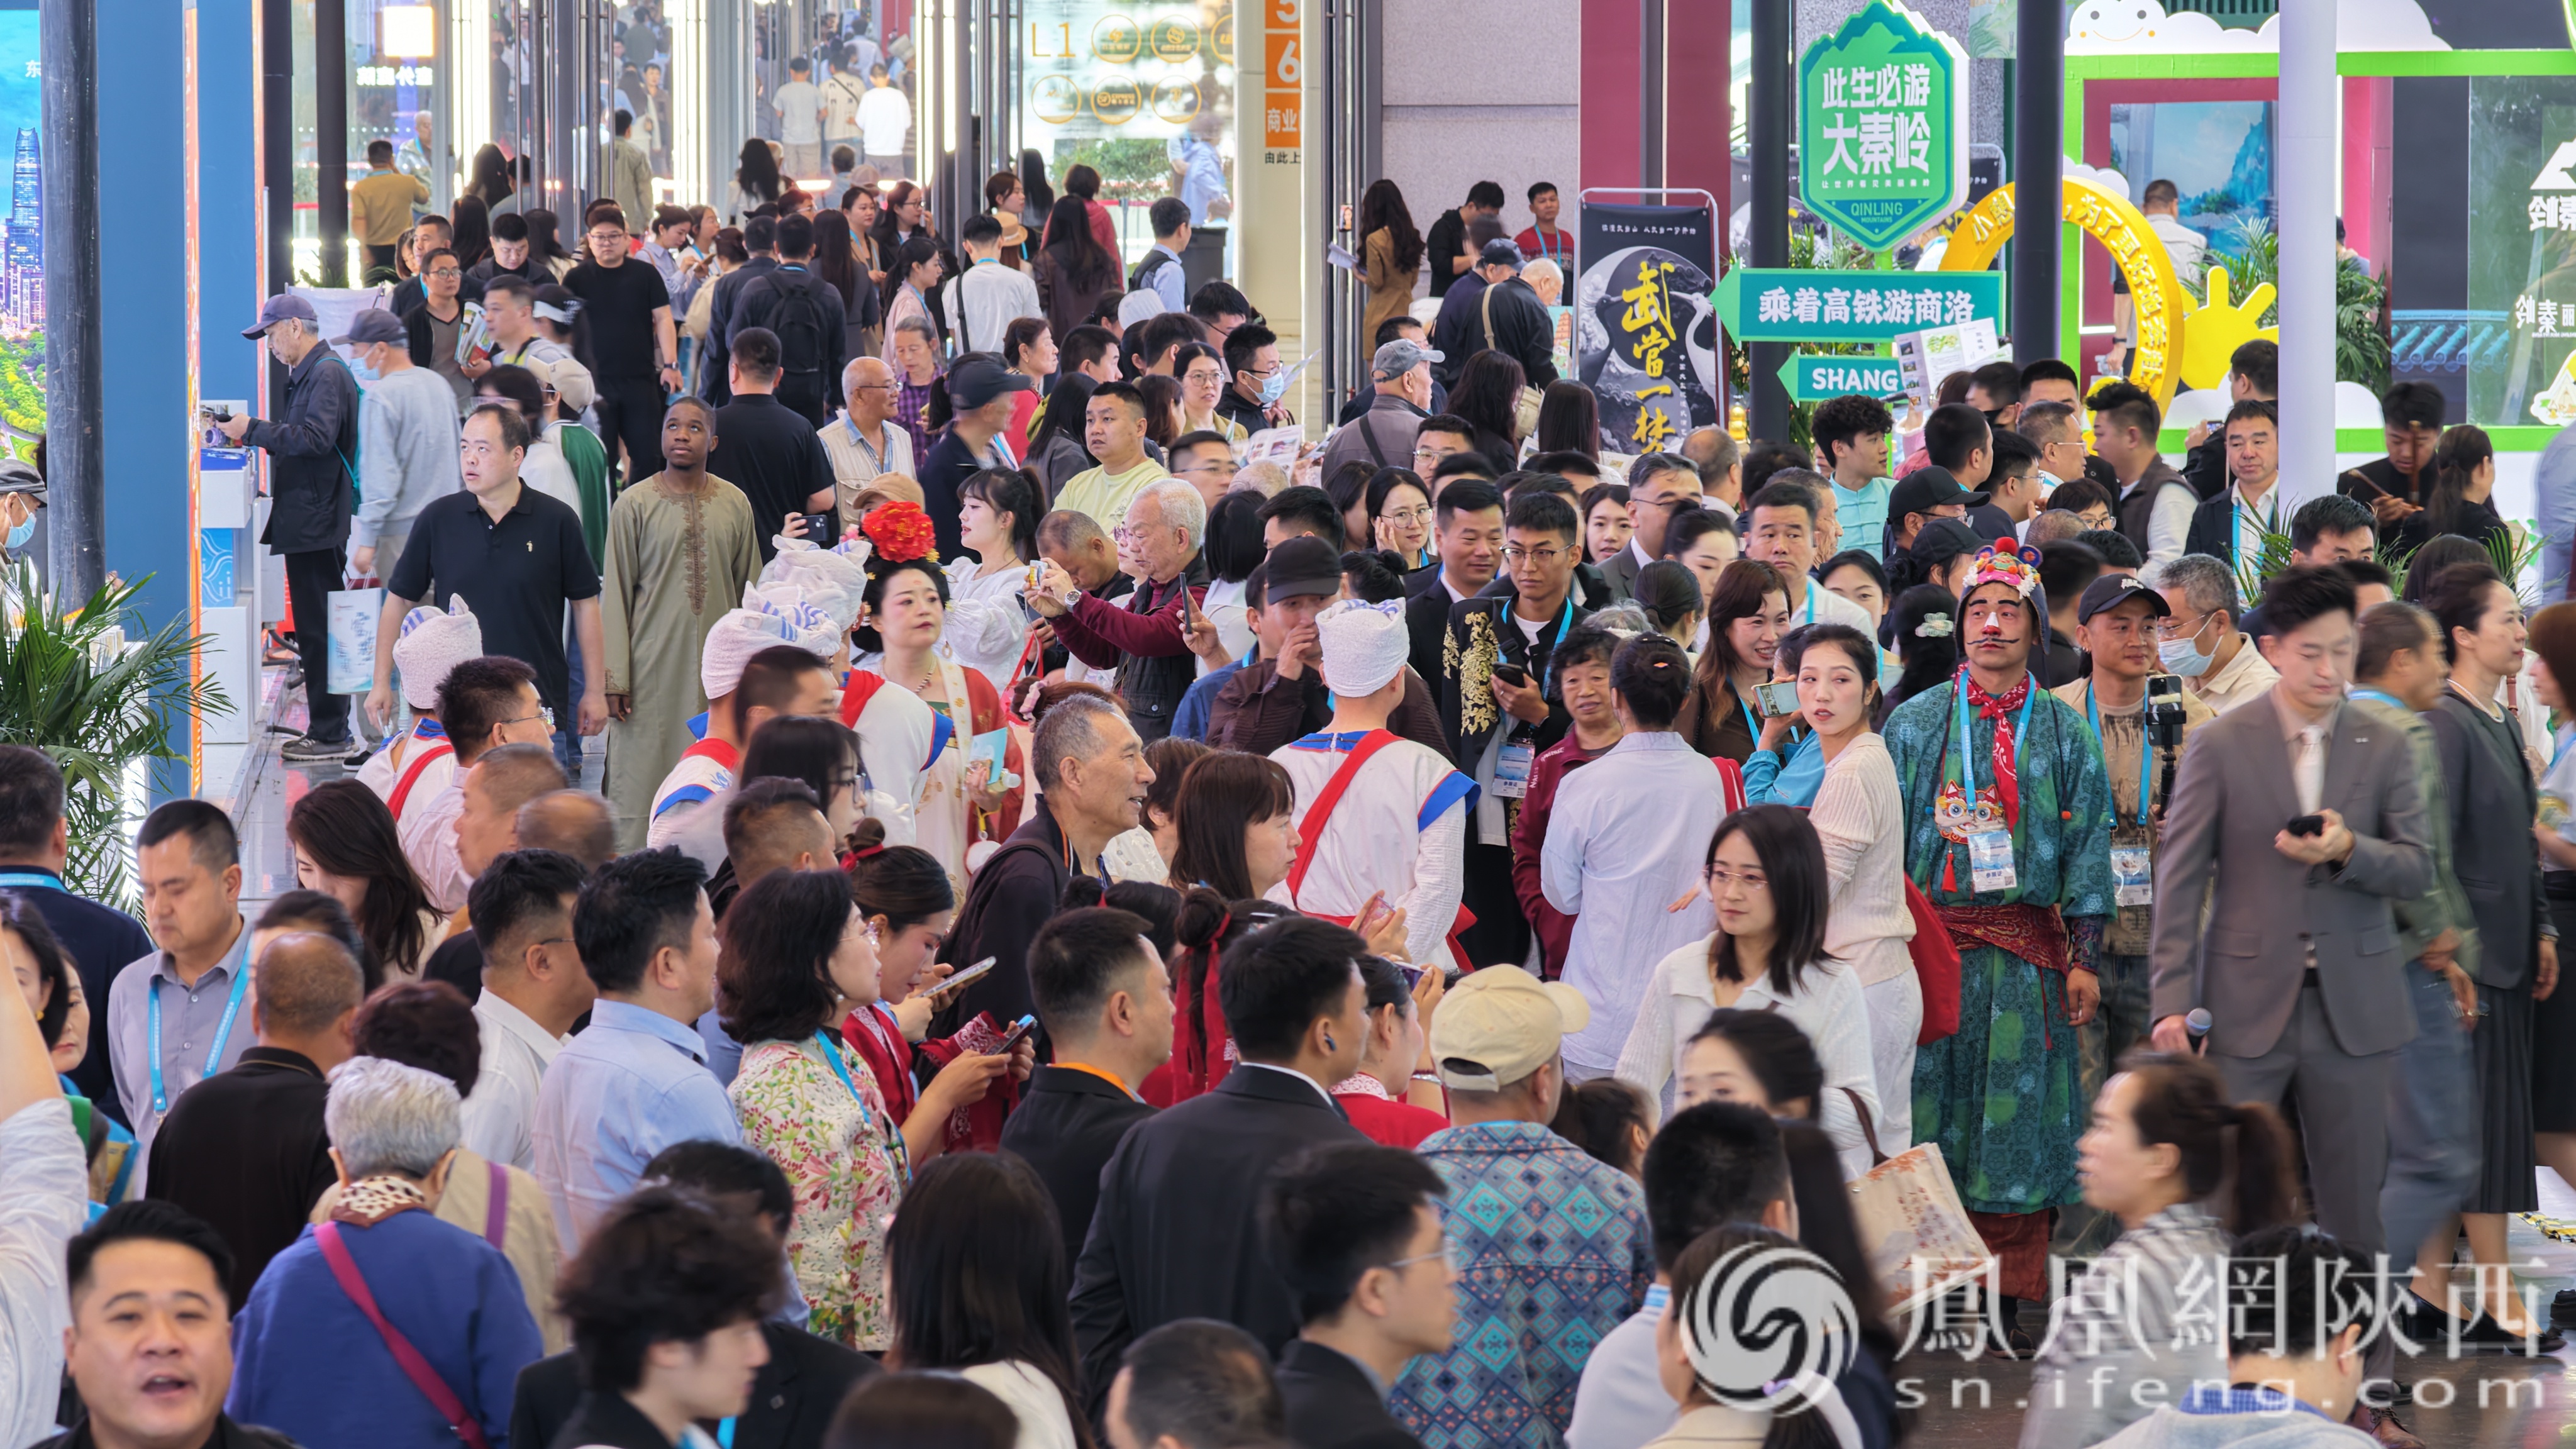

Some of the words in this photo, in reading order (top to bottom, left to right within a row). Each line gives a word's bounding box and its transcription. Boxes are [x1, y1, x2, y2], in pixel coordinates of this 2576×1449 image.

[1032, 22, 1076, 57] L1
[1277, 40, 1301, 83] 6
[1822, 64, 1931, 109] 此生必游
[1267, 108, 1301, 133] 商业
[1265, 152, 1301, 164] 由此上
[1823, 111, 1931, 175] 大秦岭
[1851, 202, 1903, 216] QINLING
[1758, 286, 1975, 325] 乘着高铁游商洛
[1812, 368, 1898, 391] SHANG
